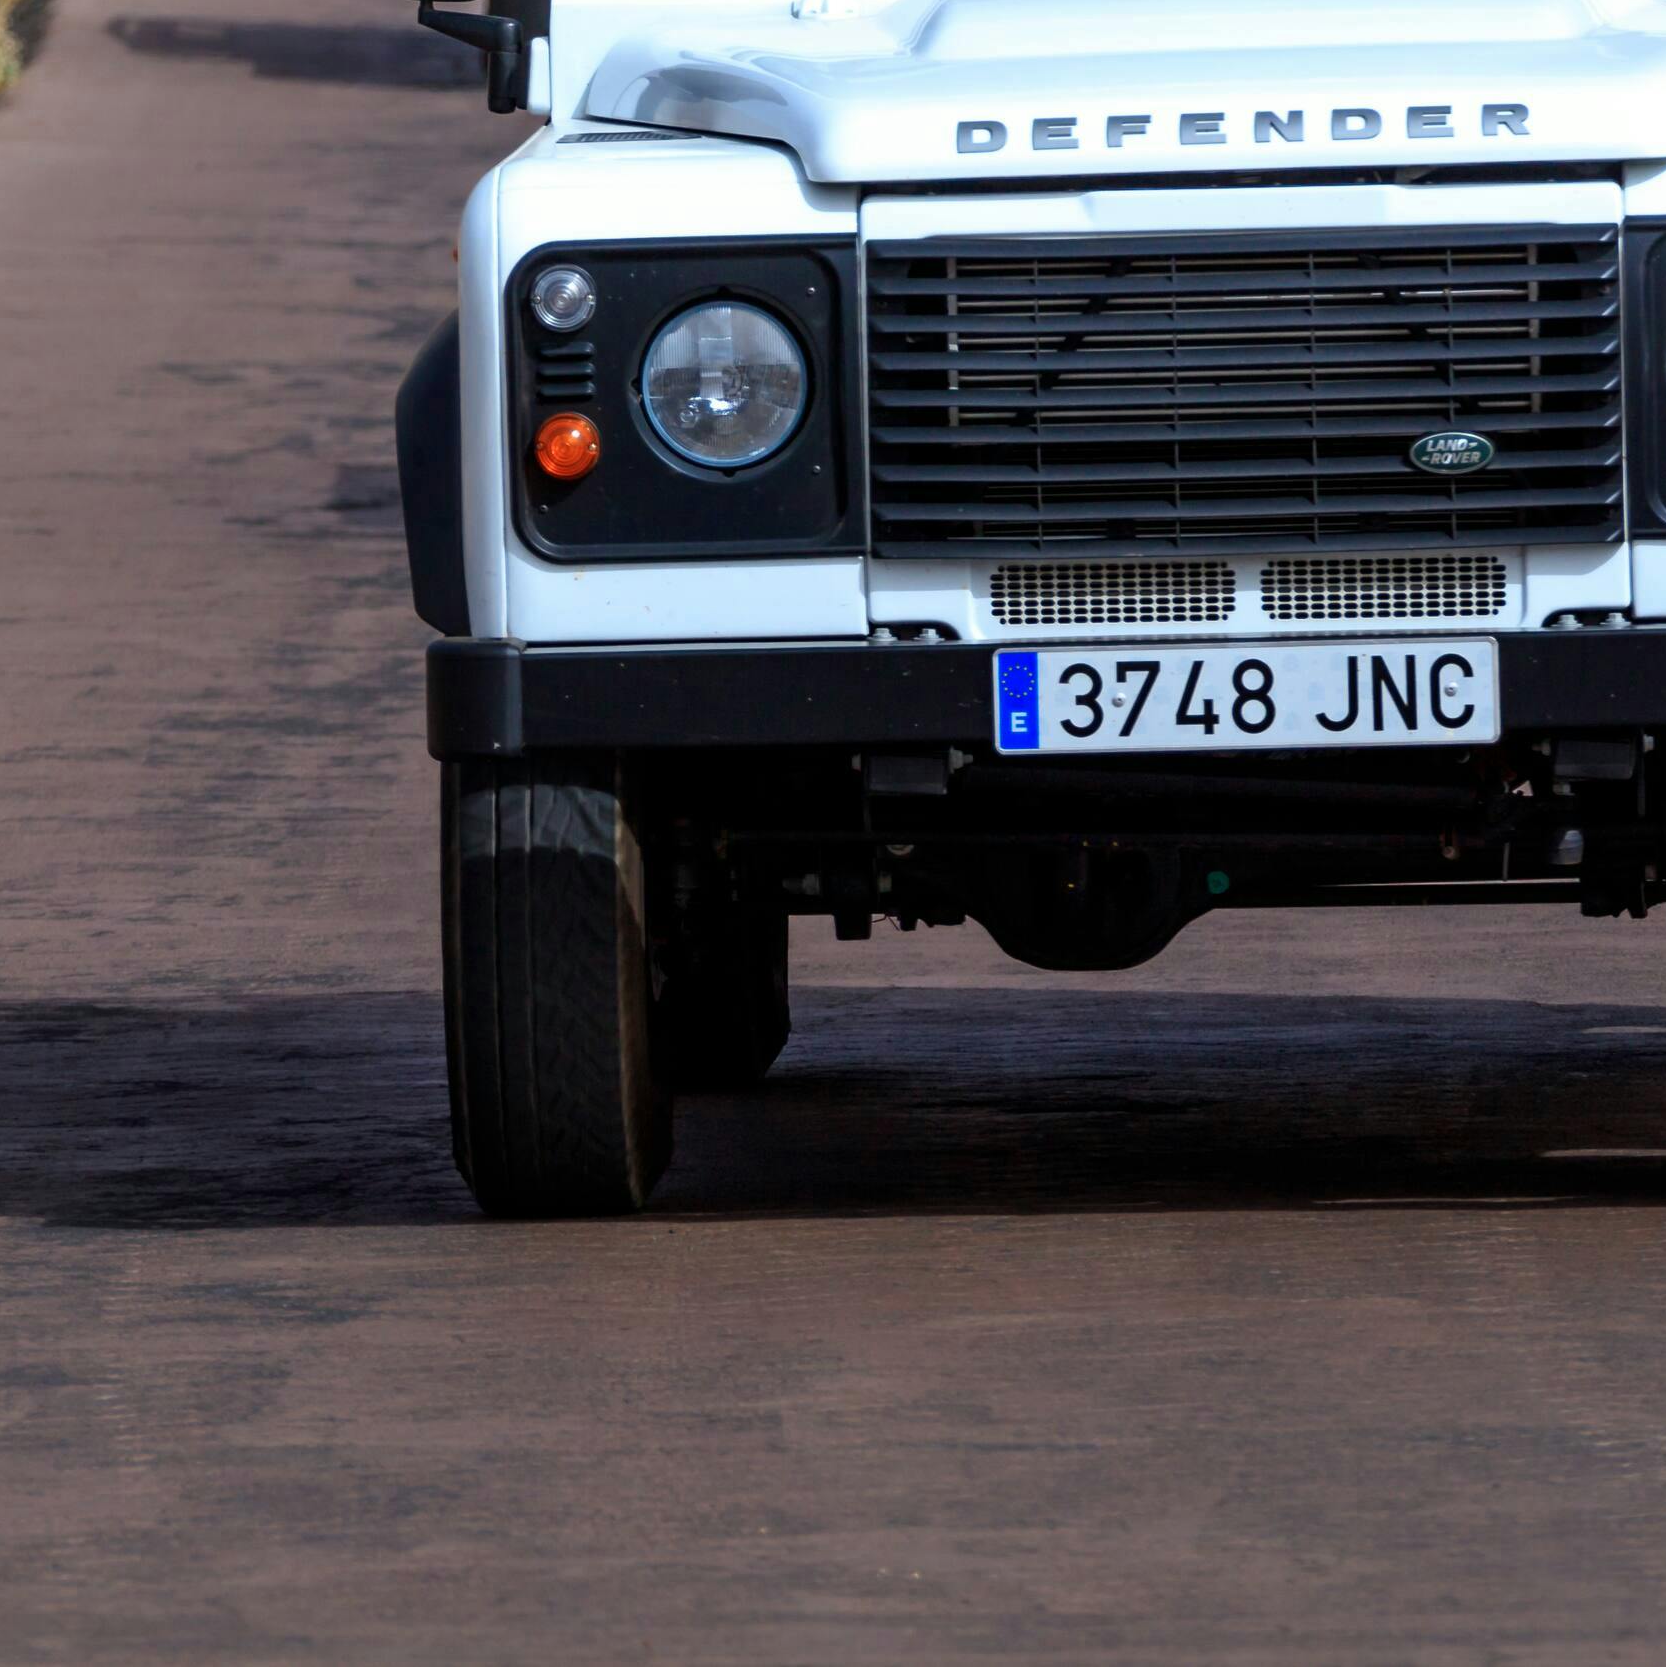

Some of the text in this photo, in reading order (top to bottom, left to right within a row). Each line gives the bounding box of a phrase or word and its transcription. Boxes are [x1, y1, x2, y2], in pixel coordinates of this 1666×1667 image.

[955, 103, 1531, 155] DEFENDER
[1427, 439, 1468, 451] LAND
[1431, 452, 1480, 464] ROVER
[1058, 653, 1475, 738] 3748 JNC
[1010, 711, 1028, 734] E
